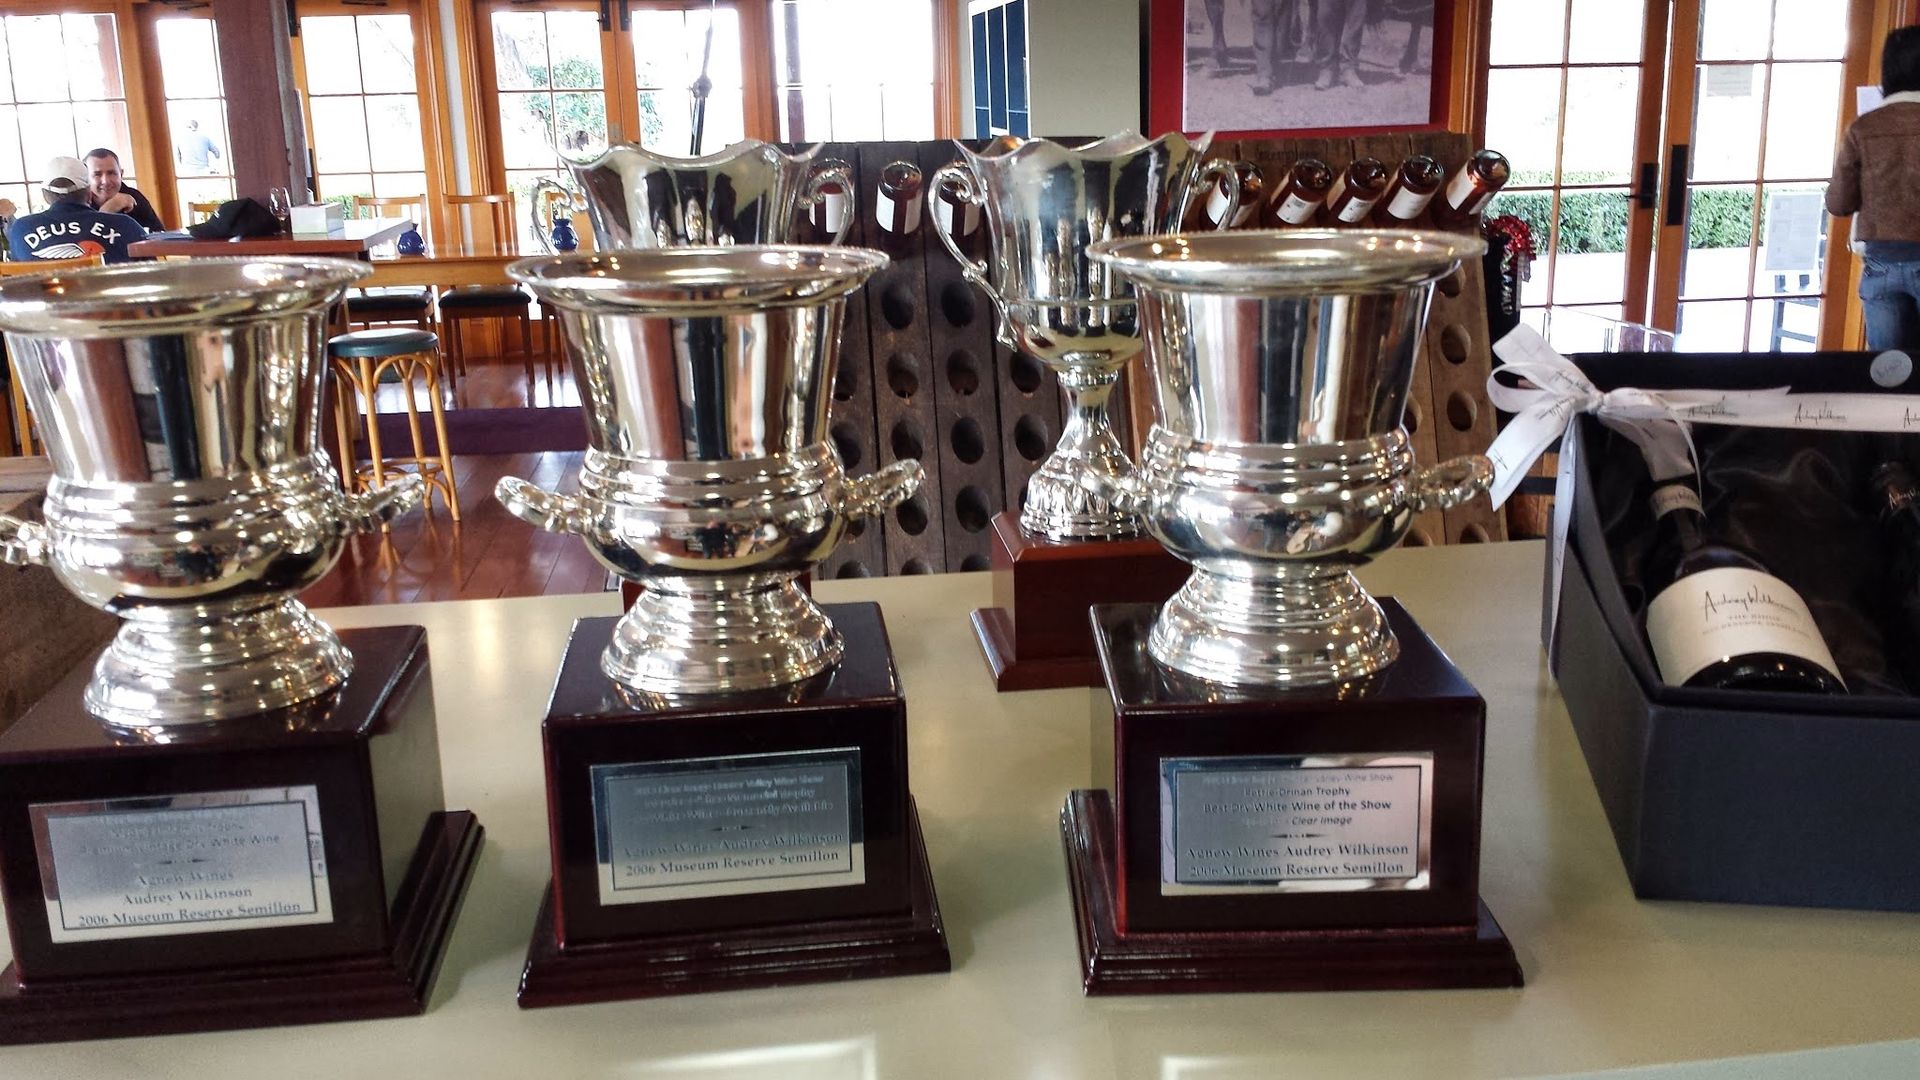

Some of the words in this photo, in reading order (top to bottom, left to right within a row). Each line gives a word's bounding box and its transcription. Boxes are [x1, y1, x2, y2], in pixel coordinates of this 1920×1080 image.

[23, 221, 82, 250] DEUS
[89, 222, 122, 245] EX
[1316, 786, 1351, 798] Trophy
[1203, 803, 1229, 814] Best
[1254, 802, 1288, 813] White
[1291, 801, 1321, 812] Wine
[1323, 800, 1336, 811] of
[1338, 799, 1357, 810] the
[1360, 799, 1392, 810] Show
[1291, 816, 1318, 826] Clear
[1320, 815, 1353, 827] Image
[718, 836, 769, 851] Audrey
[772, 831, 843, 847] Wilkinson
[1187, 847, 1232, 860] Agnew
[1236, 846, 1280, 858] Wines
[1284, 844, 1335, 859] Audrey
[1337, 843, 1410, 857] Wilkinson
[659, 860, 719, 874] Museum
[723, 856, 776, 870] Reserve
[779, 849, 840, 864] Semillon
[1222, 863, 1282, 876] Museum
[1285, 862, 1340, 875] Reserve
[1342, 860, 1405, 875] Semillon
[138, 873, 184, 888] Agnew
[124, 891, 173, 906] Audrey
[179, 887, 253, 901] Wilkinson
[78, 914, 110, 927] 2006
[111, 910, 175, 924] Museum
[178, 906, 234, 920] Reserve
[237, 900, 302, 915] Semillon
